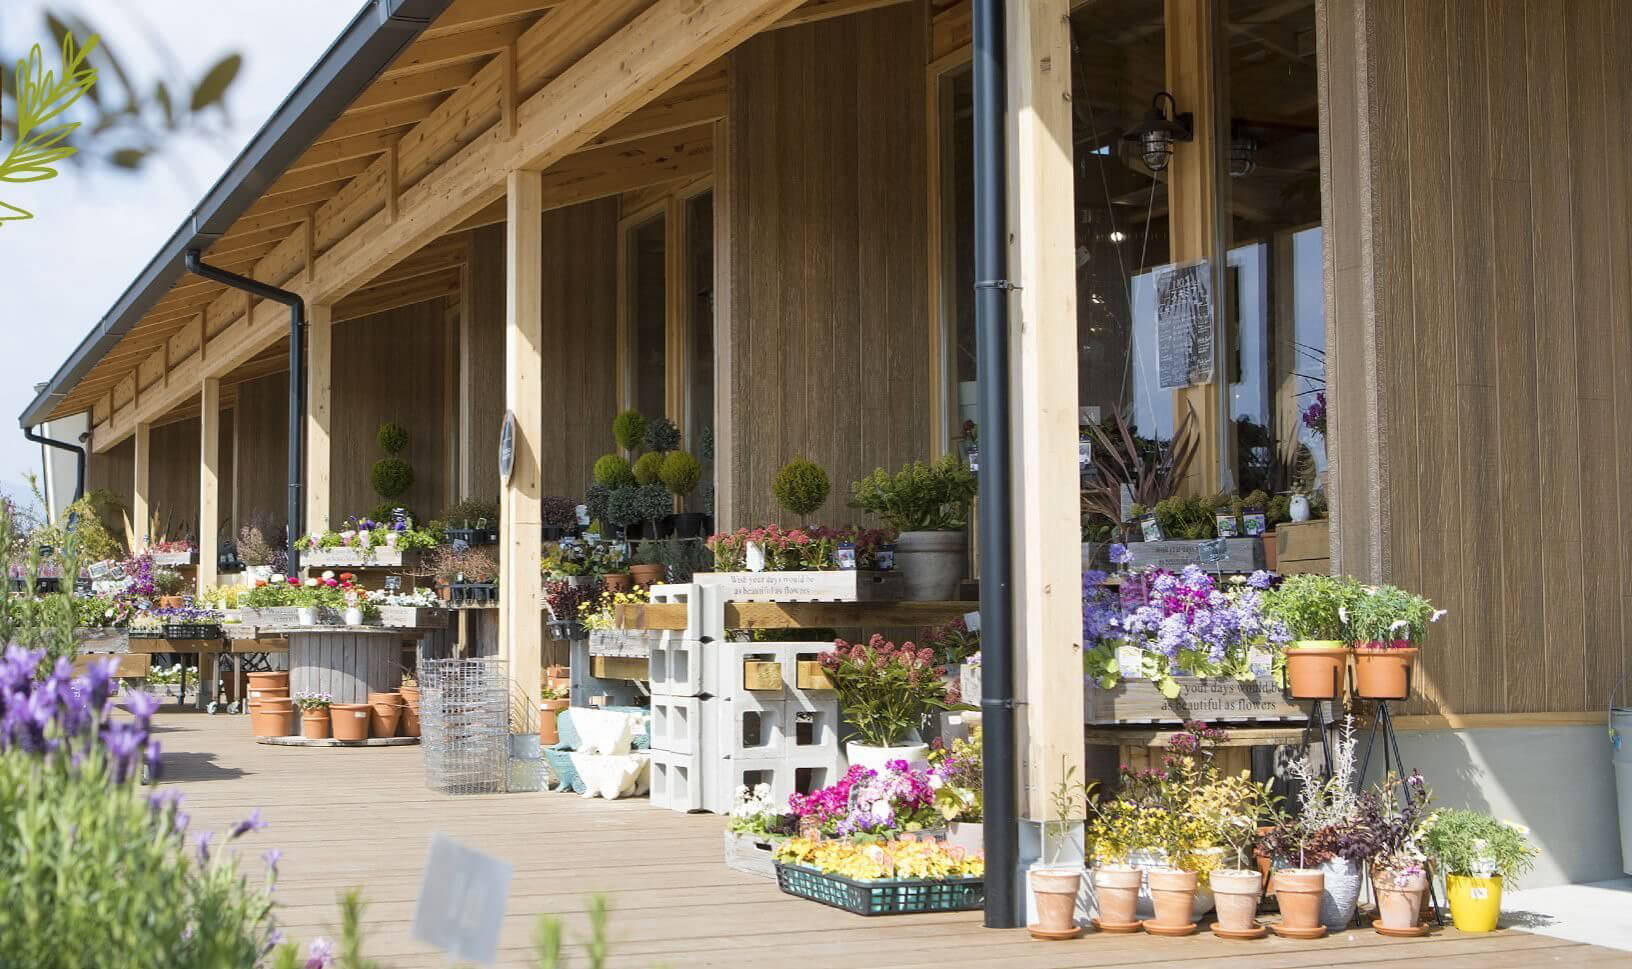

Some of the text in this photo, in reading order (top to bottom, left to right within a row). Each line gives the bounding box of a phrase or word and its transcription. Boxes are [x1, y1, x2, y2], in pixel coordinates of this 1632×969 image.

[730, 575, 747, 584] Wish
[1184, 683, 1207, 696] your
[1210, 681, 1234, 696] days
[1161, 702, 1171, 711] as
[1224, 702, 1235, 711] as
[1238, 698, 1276, 711] flowers
